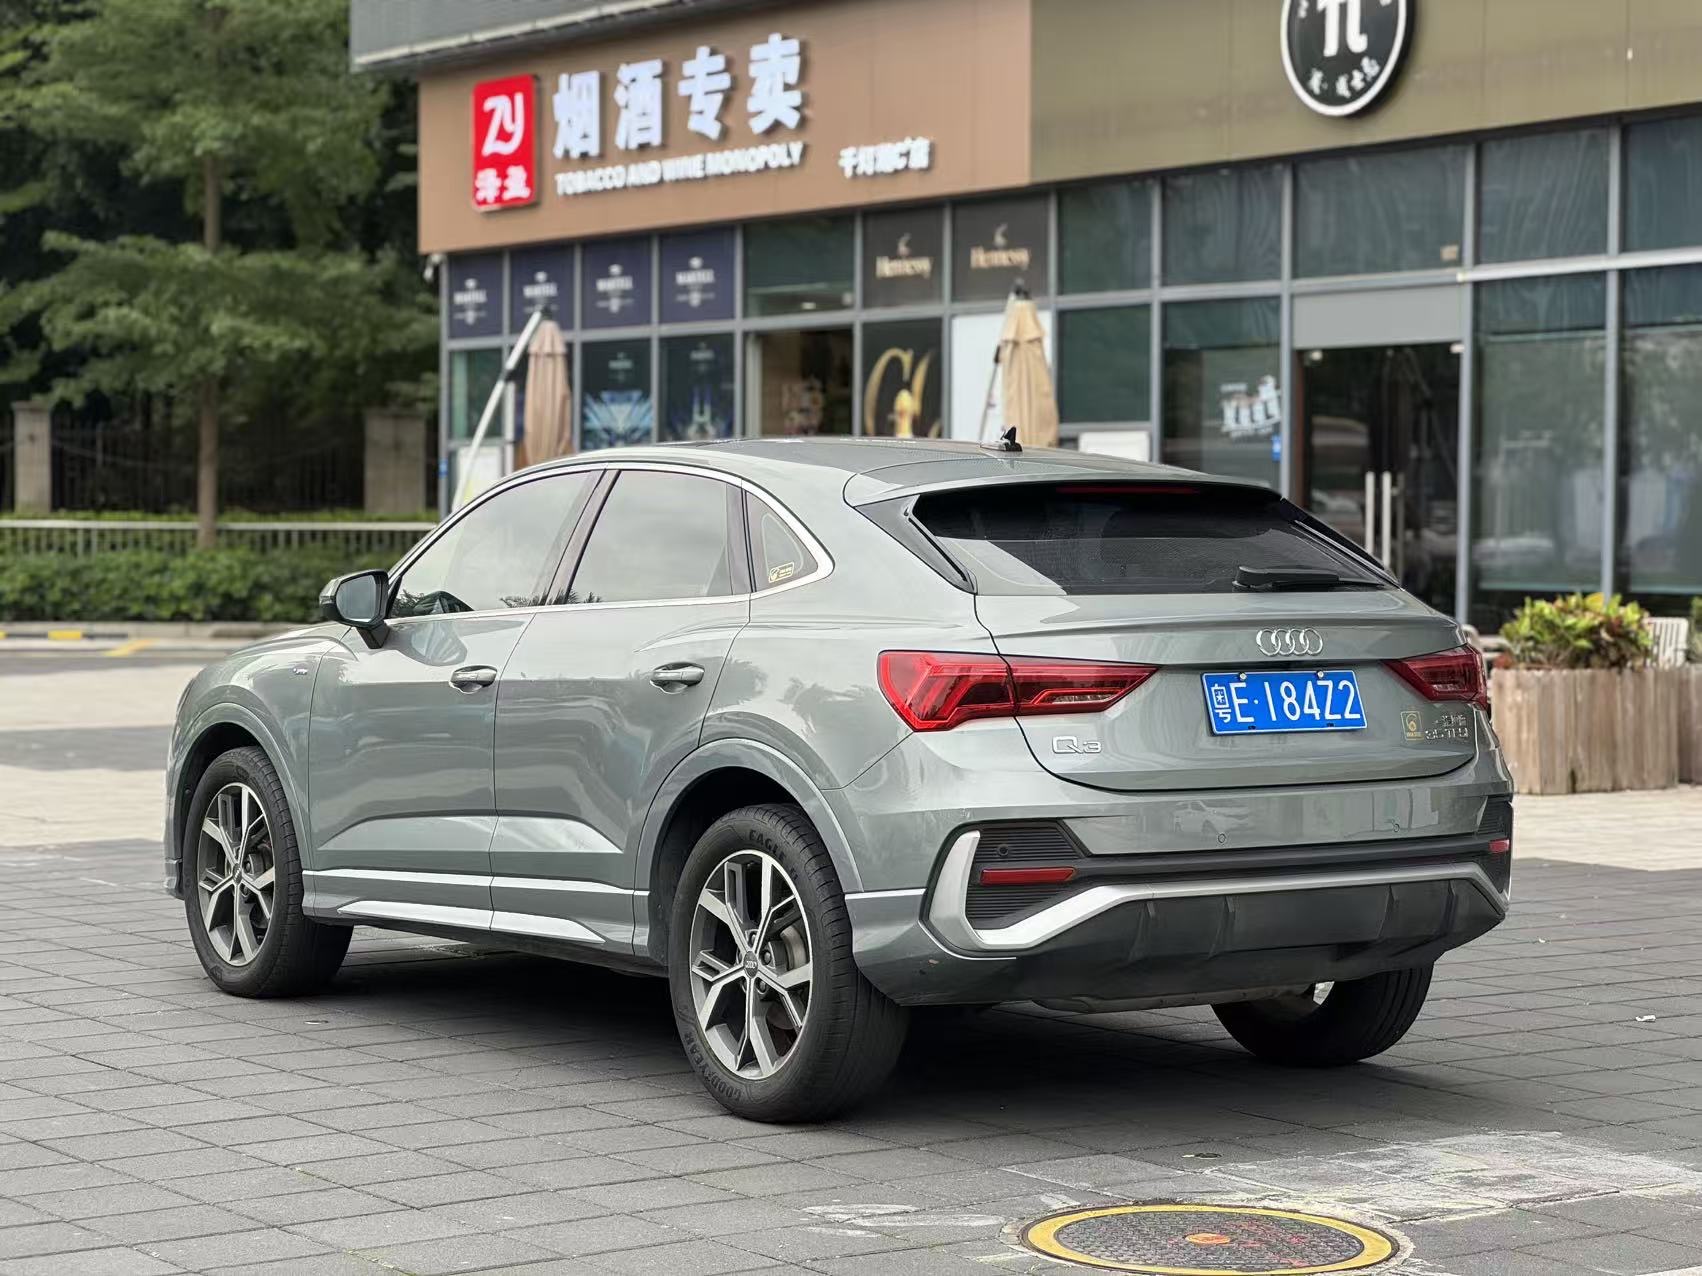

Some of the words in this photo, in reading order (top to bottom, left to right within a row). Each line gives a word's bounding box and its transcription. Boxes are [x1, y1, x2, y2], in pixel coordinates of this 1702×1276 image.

[553, 32, 803, 159] 烟酒专卖
[554, 166, 626, 196] TOBACCO
[626, 160, 662, 187] AND
[661, 154, 705, 182] WINE
[705, 141, 804, 176] MONOPOLY
[1052, 735, 1102, 755] Q3
[749, 829, 787, 861] EAGLE
[684, 1031, 742, 1101] GOODYEAR
